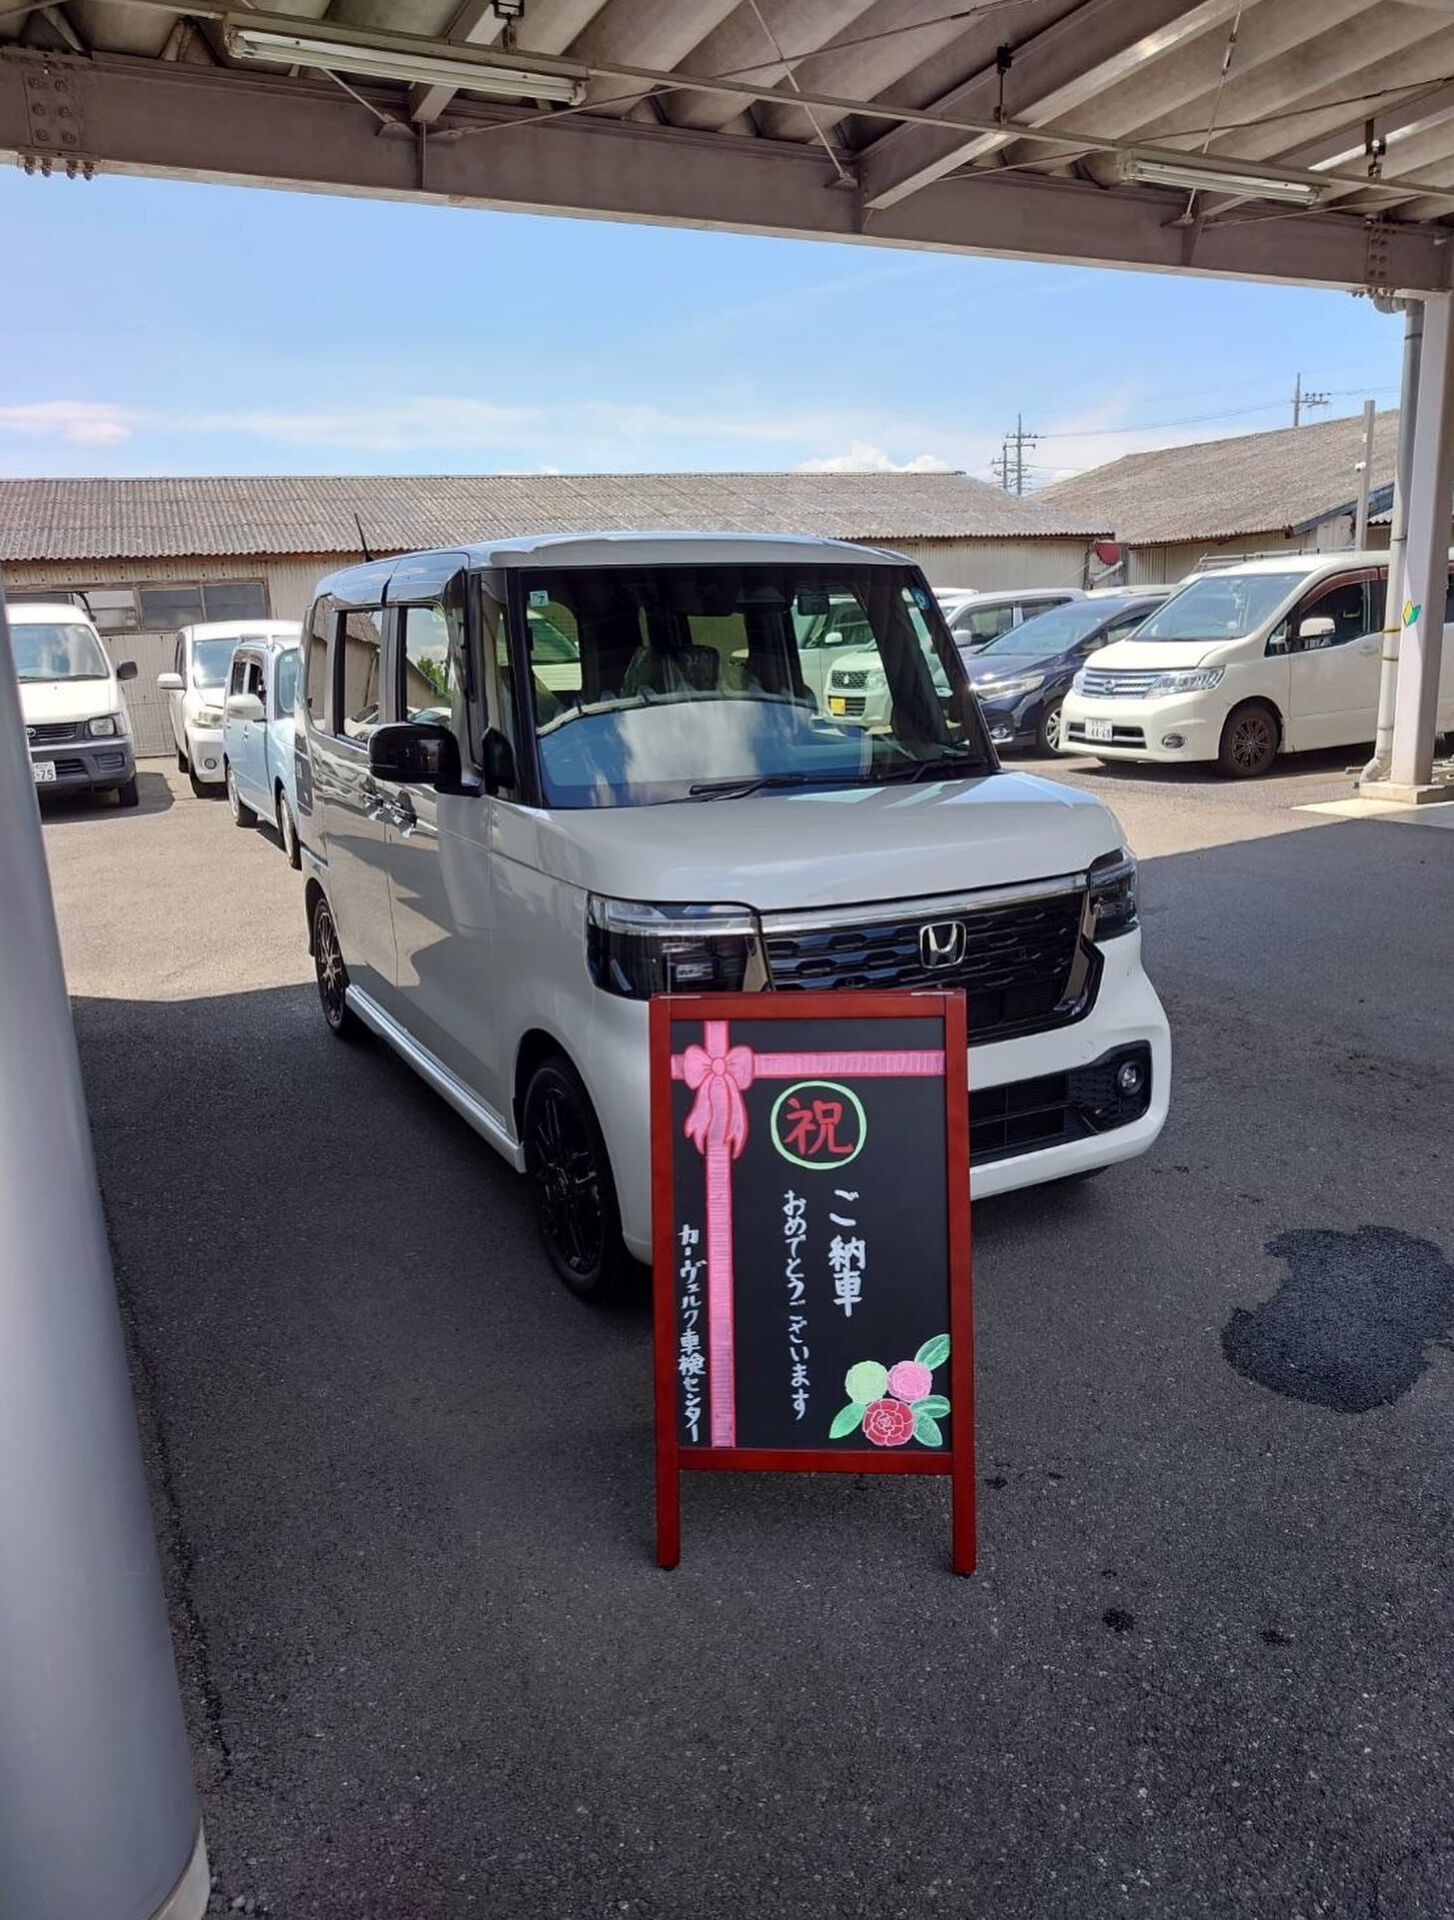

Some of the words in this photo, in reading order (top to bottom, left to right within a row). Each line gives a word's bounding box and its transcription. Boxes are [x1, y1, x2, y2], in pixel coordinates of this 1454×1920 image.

[783, 1097, 854, 1155] 祝
[782, 1189, 810, 1420] おめでとうございます
[828, 1189, 866, 1317] ご納車
